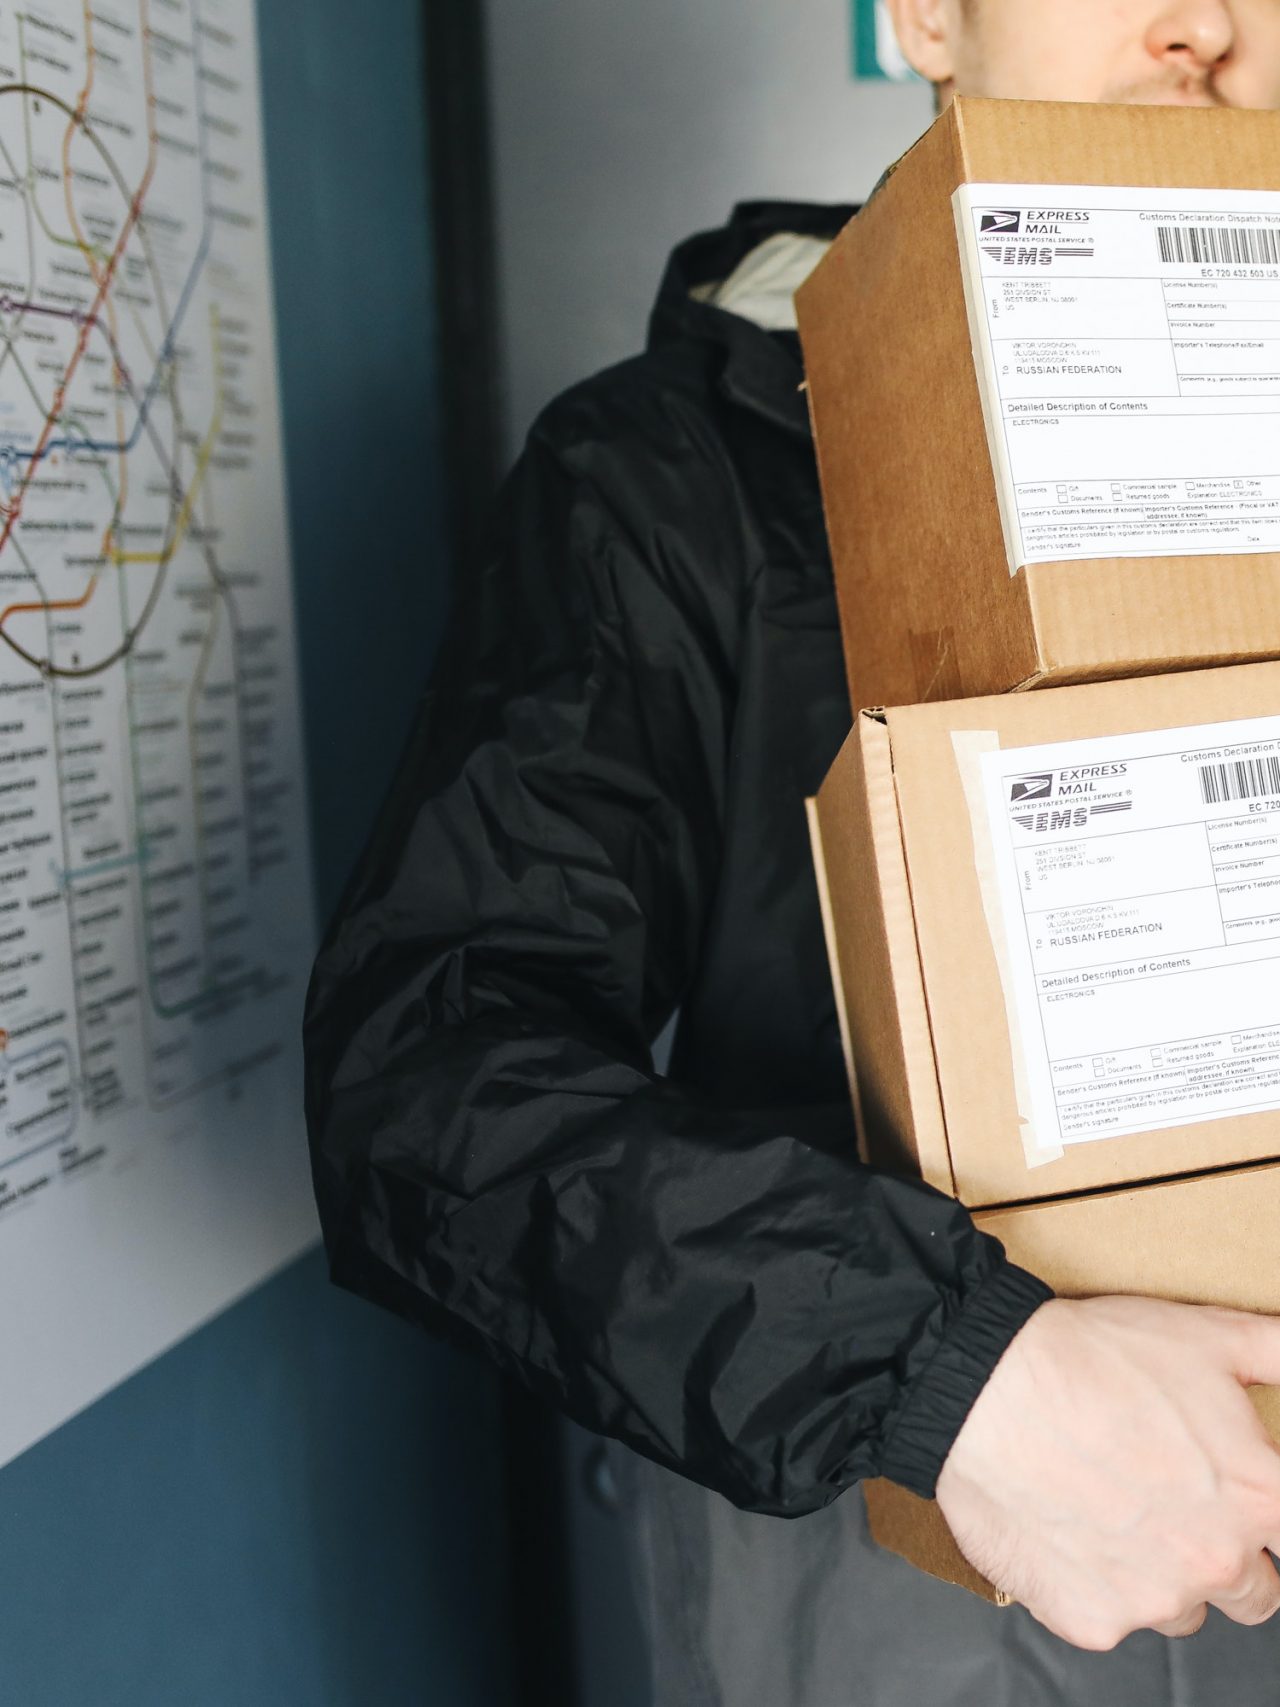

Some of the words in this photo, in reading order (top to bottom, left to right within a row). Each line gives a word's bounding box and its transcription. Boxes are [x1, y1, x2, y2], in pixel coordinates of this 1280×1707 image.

[1027, 211, 1090, 221] EXPRESS
[1139, 213, 1176, 221] Customs
[1179, 214, 1224, 222] Declaration
[1228, 214, 1262, 223] Dispatch
[1025, 224, 1061, 234] MAIL
[1003, 247, 1053, 265] EMS
[1201, 269, 1213, 277] EC
[1250, 270, 1264, 278] 503
[1266, 270, 1279, 278] US
[1017, 366, 1060, 374] RUSSIAN
[1062, 366, 1122, 374] FEDERATION
[1008, 403, 1044, 412] Detailed
[1046, 403, 1096, 412] Description
[1109, 402, 1148, 410] Contents
[1180, 751, 1221, 763] Customs
[1224, 744, 1275, 757] Declaration
[1060, 763, 1127, 781] EXPRESS
[1058, 782, 1096, 796] MAIL
[1009, 804, 1036, 812] UNITED
[1038, 800, 1063, 808] STATES
[1064, 796, 1091, 805] POSTAL
[1094, 791, 1122, 801] SERVICE
[1249, 803, 1262, 812] EC
[1265, 800, 1280, 810] 720
[1036, 807, 1087, 832] EMS
[1207, 821, 1232, 830] License
[1234, 817, 1267, 827] Number(s)
[1211, 842, 1243, 852] Certificate
[1245, 837, 1277, 848] Number(s)
[1215, 864, 1238, 872] Invoice
[1240, 860, 1264, 869] Number
[1219, 884, 1252, 894] Importer's
[1050, 933, 1095, 947] RUSSIAN
[1098, 922, 1163, 940] FEDERATION
[1042, 975, 1079, 988] Detailed
[1081, 966, 1135, 982] Description
[1138, 965, 1147, 973] of
[1149, 959, 1191, 972] Contents
[1047, 990, 1095, 1002] ELECTRONICS
[1053, 1063, 1083, 1072] Contents
[1188, 1064, 1220, 1075] Importer's
[1221, 1060, 1250, 1071] Customs
[1231, 1066, 1254, 1076] known)
[1058, 1087, 1087, 1096] Sender's
[1088, 1082, 1117, 1091] Customs
[1119, 1077, 1151, 1086] Reference
[1160, 1070, 1185, 1080] known)
